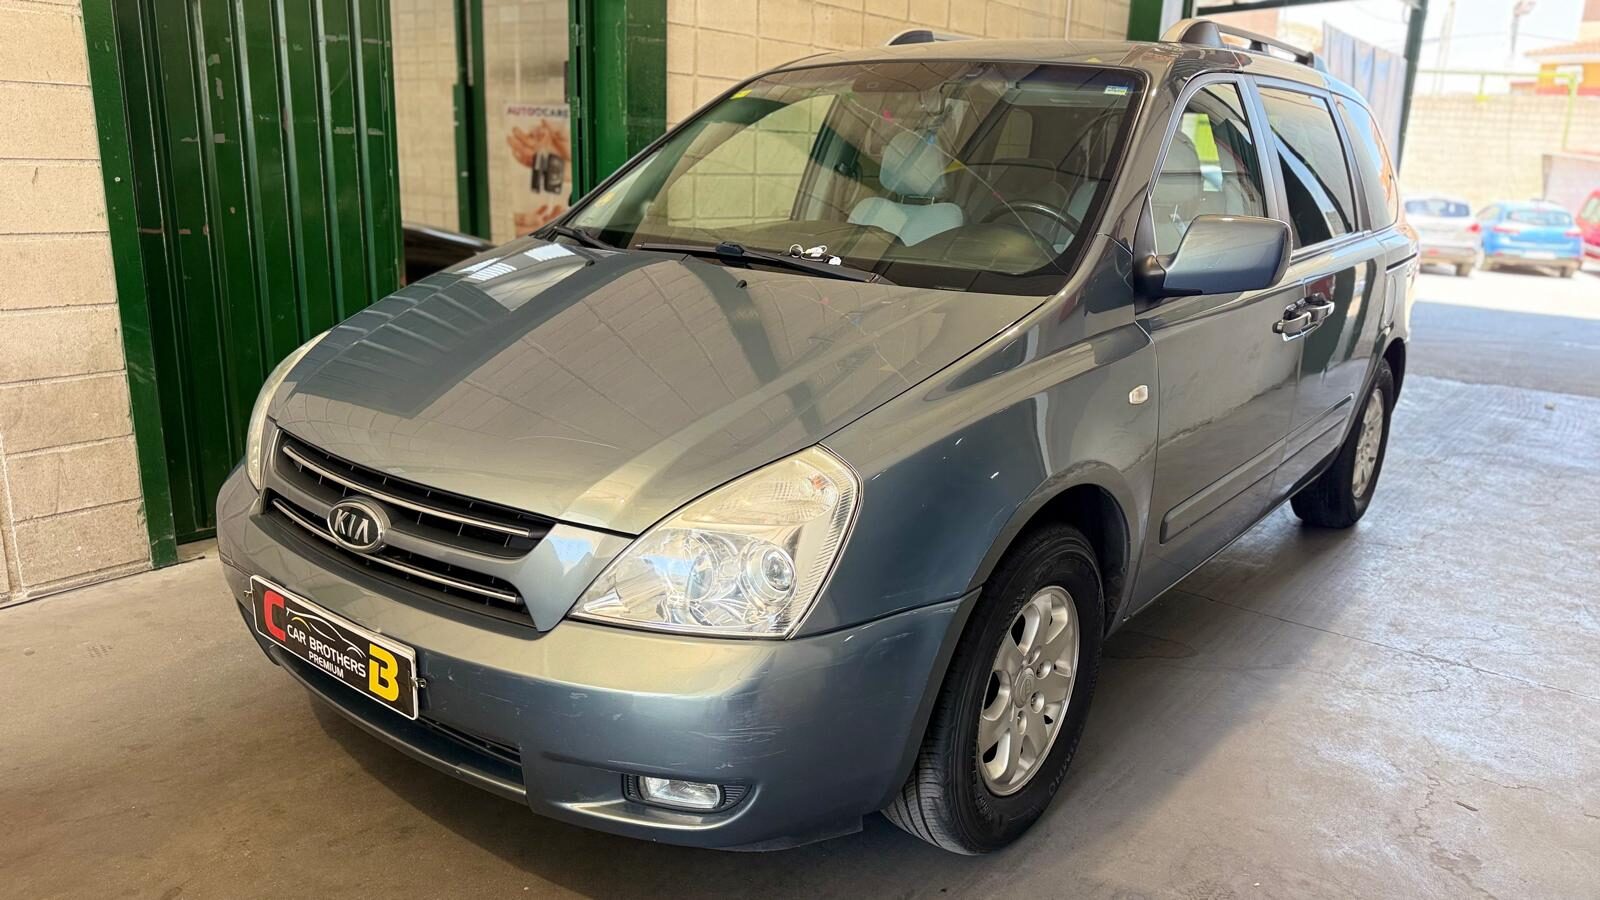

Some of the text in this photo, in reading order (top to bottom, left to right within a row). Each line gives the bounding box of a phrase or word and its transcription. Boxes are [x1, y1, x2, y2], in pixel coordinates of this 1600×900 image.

[335, 509, 369, 544] KIA
[287, 624, 366, 678] CAR BROTHERS
[309, 651, 344, 679] PREMIUM
